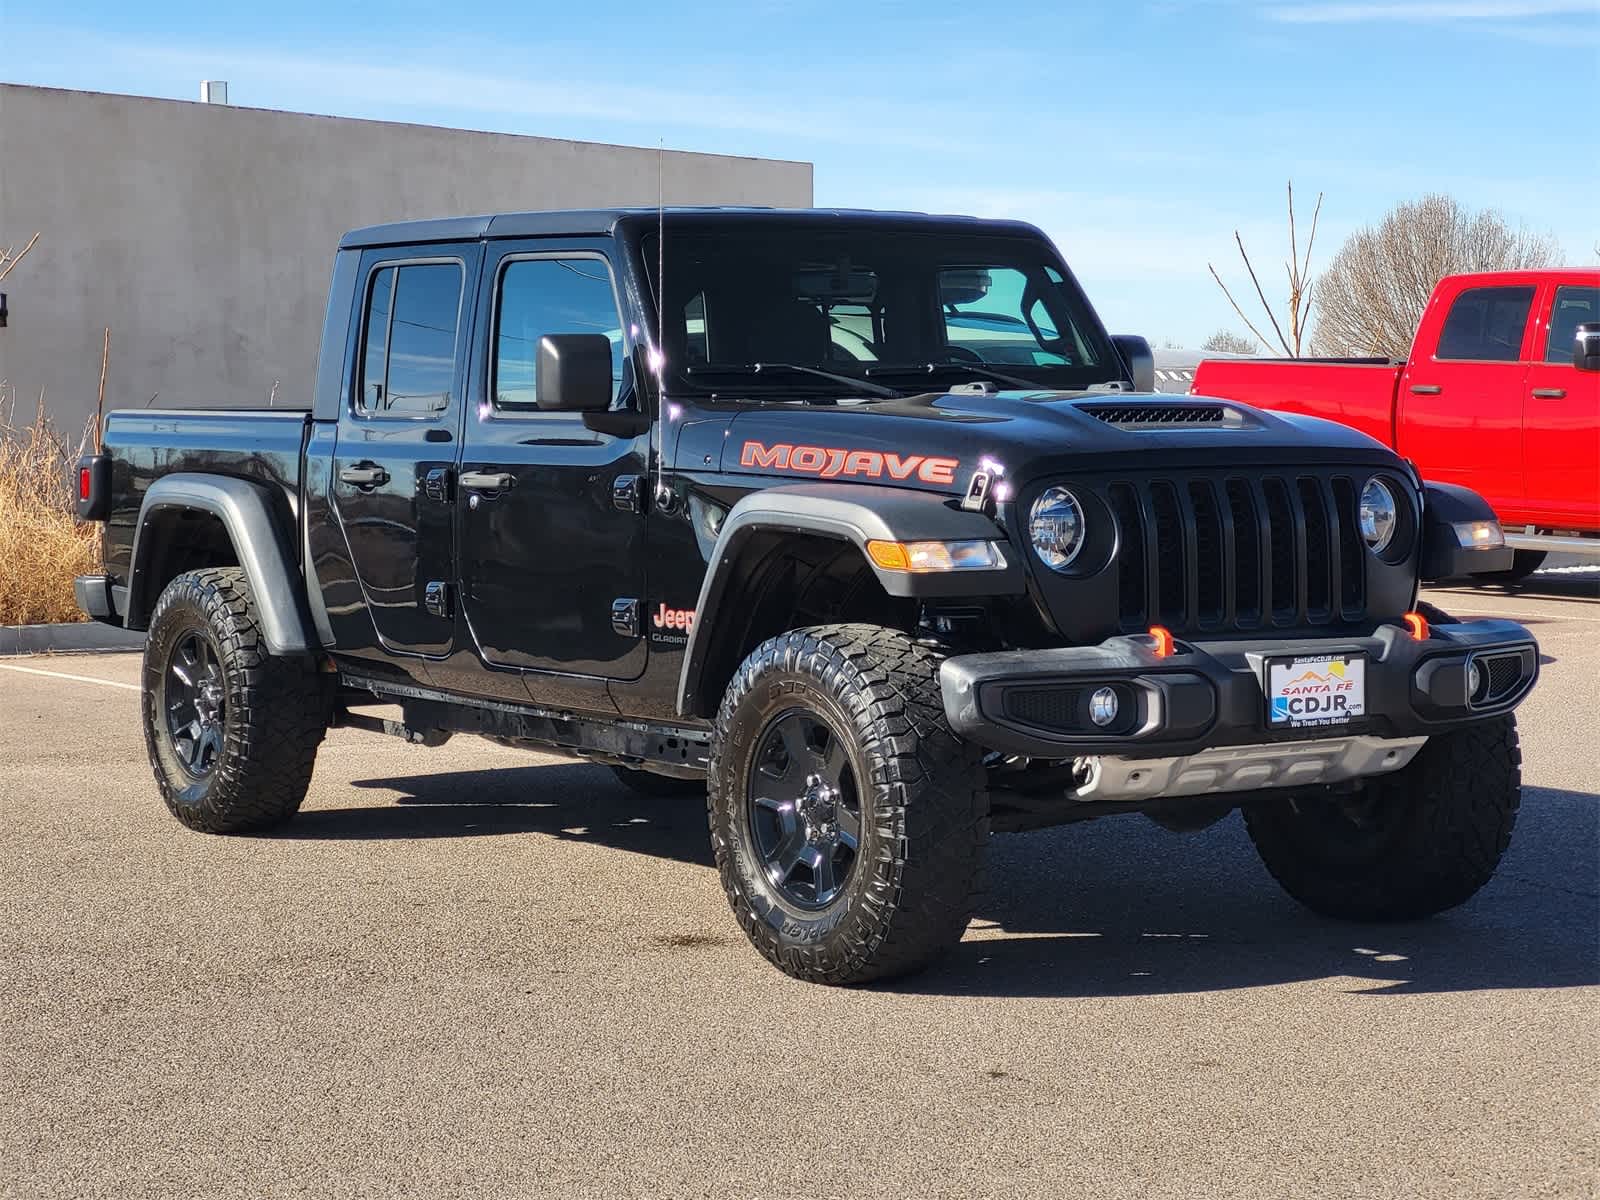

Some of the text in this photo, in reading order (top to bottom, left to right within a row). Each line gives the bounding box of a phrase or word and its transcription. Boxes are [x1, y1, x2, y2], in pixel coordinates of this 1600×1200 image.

[741, 441, 959, 484] MOJAVE
[653, 603, 695, 635] Jeep
[652, 633, 688, 644] GLADIAT
[1294, 655, 1345, 664] SantaFeCDJR.com
[1281, 682, 1354, 696] SANTA FE
[1291, 717, 1350, 728] We Treat You Better
